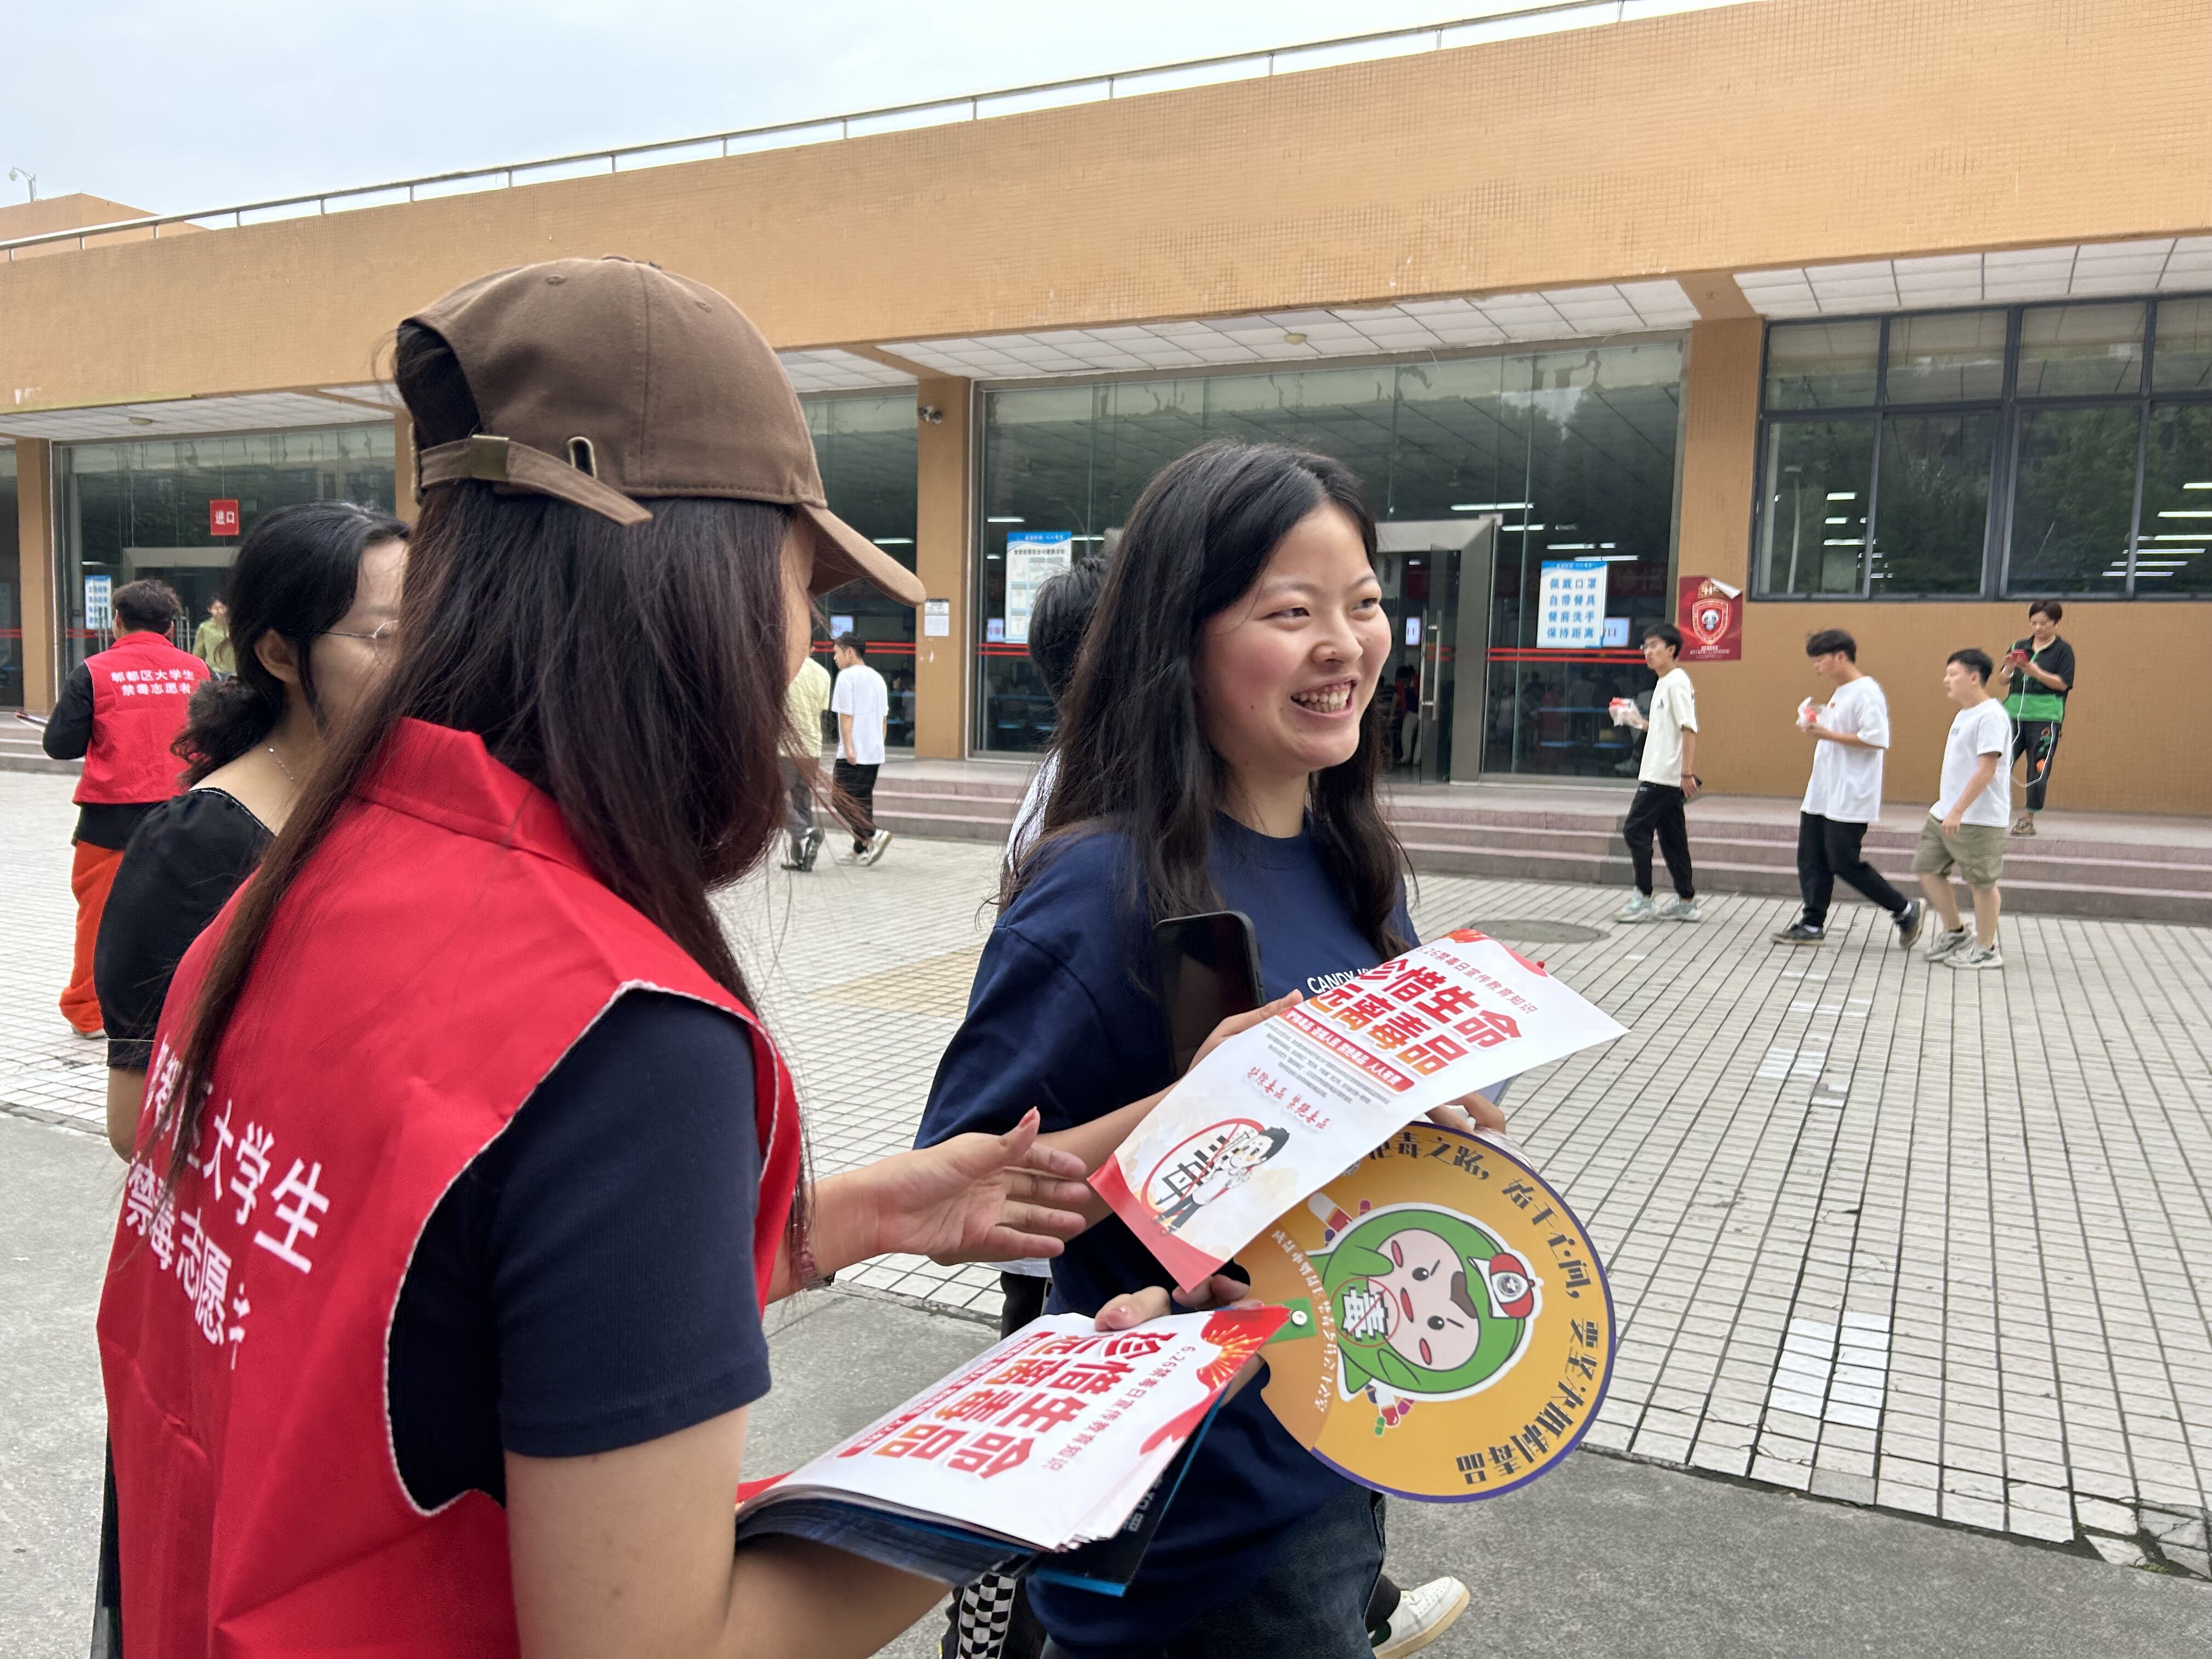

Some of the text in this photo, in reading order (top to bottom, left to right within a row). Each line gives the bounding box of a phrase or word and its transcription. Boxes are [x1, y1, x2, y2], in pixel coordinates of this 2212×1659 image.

[215, 510, 235, 525] 进口
[1550, 578, 1596, 589] 佩戴口罩
[1549, 594, 1595, 606] 自带餐具
[1548, 611, 1594, 623] 餐前洗手
[1547, 627, 1593, 639] 保持距离
[111, 669, 194, 683] 郫都区大学生
[121, 682, 191, 696] 禁毒志愿者
[1309, 983, 1469, 1076] 远离毒品
[947, 1331, 1178, 1479] 珍惜生命
